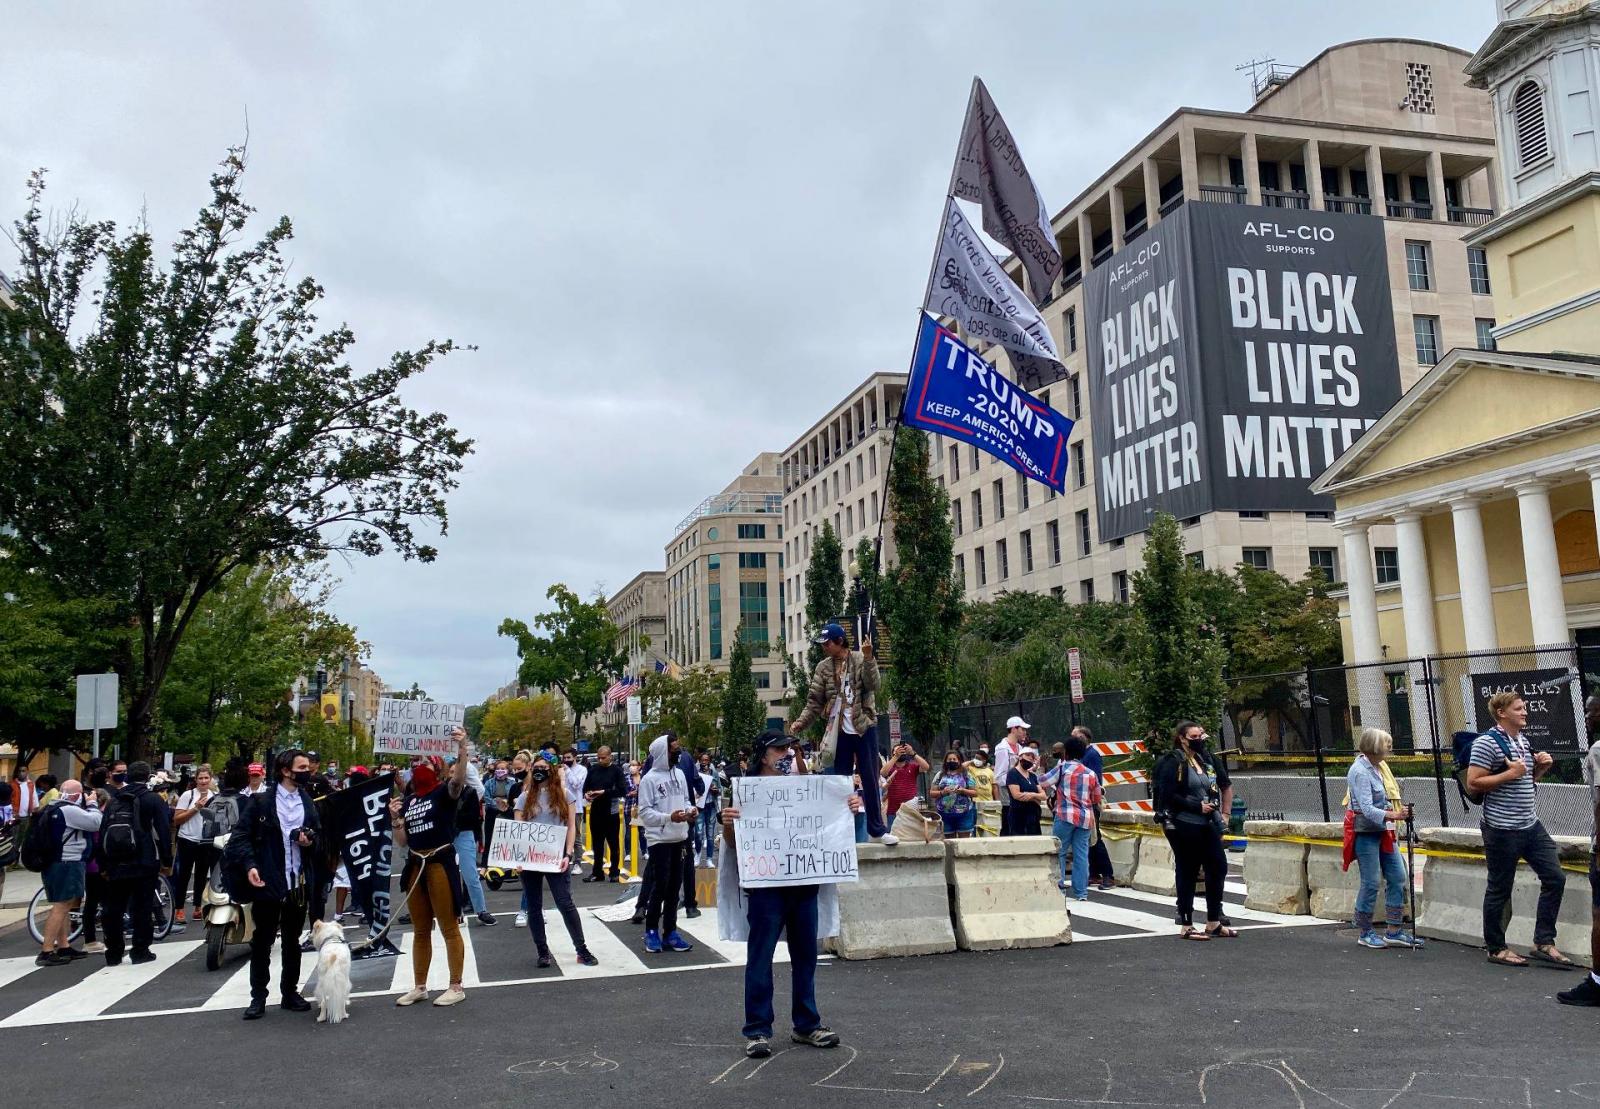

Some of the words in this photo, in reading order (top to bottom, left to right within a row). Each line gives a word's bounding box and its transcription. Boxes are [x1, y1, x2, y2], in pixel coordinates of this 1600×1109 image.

[1243, 221, 1335, 243] AFL-CIO
[1265, 244, 1316, 256] SUPPORTS
[1109, 240, 1161, 287] AFL-CIO
[1120, 269, 1149, 293] SUPPORTS
[1227, 267, 1364, 335] BLACK
[1101, 279, 1180, 376] BLACK
[943, 336, 1056, 440] TRUMP
[1110, 354, 1179, 440] LIVES
[1245, 340, 1361, 408] LIVES
[926, 400, 961, 419] KEEP
[961, 413, 1015, 449] AMERICA
[1101, 420, 1202, 512] MATTER
[382, 721, 399, 735] WHO
[383, 701, 415, 720] HERE
[421, 702, 439, 720] FOR
[440, 704, 461, 723] ALL
[765, 788, 789, 806] you
[796, 779, 824, 801] still
[764, 838, 781, 851] us
